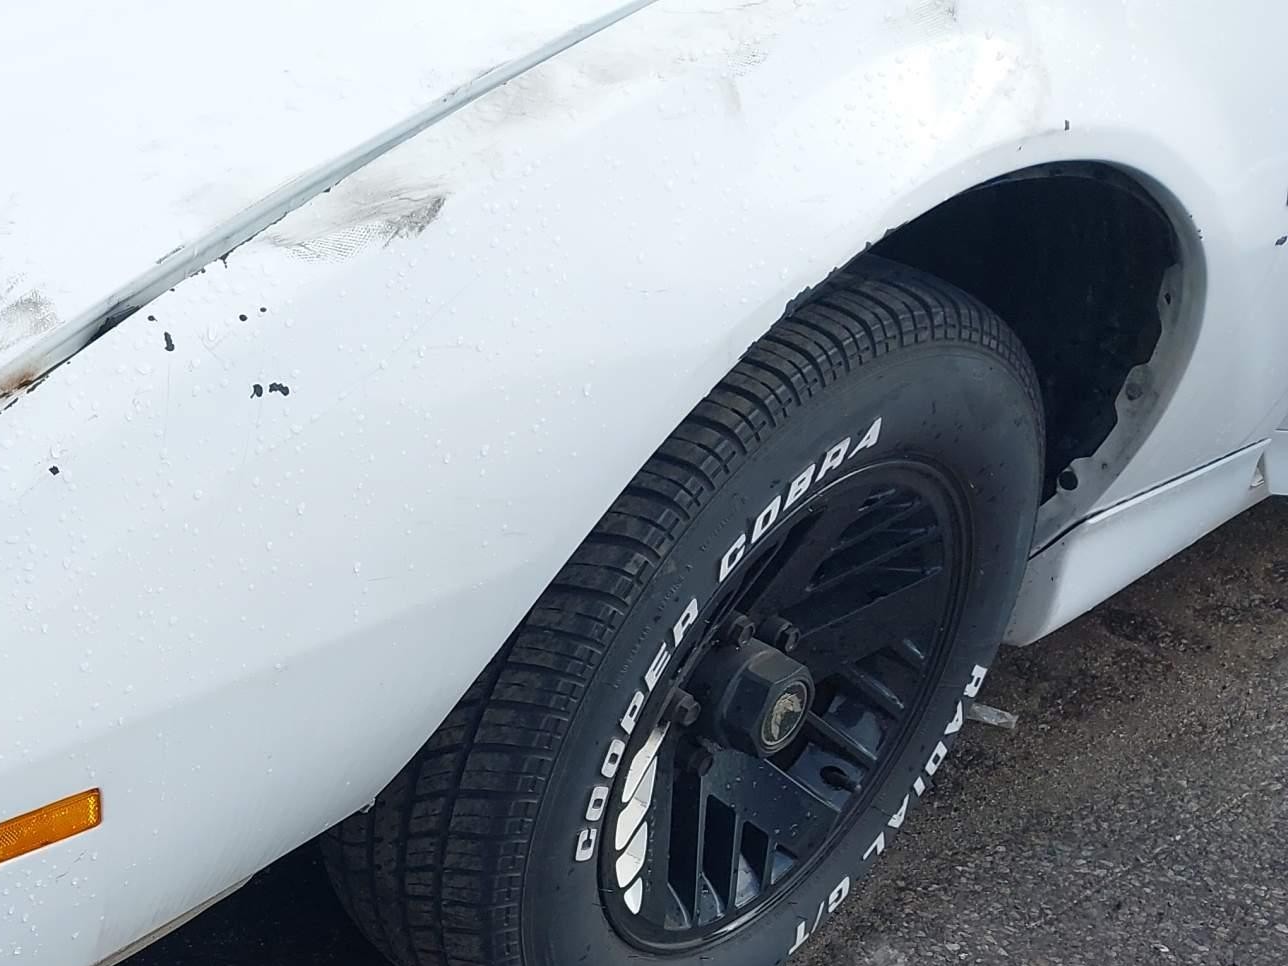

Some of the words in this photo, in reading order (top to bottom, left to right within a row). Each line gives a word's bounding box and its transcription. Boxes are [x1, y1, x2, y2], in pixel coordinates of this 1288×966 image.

[574, 598, 700, 862] COOPER
[718, 416, 883, 583] COBRA
[862, 663, 989, 861] RADIAL
[788, 875, 851, 956] G/T
